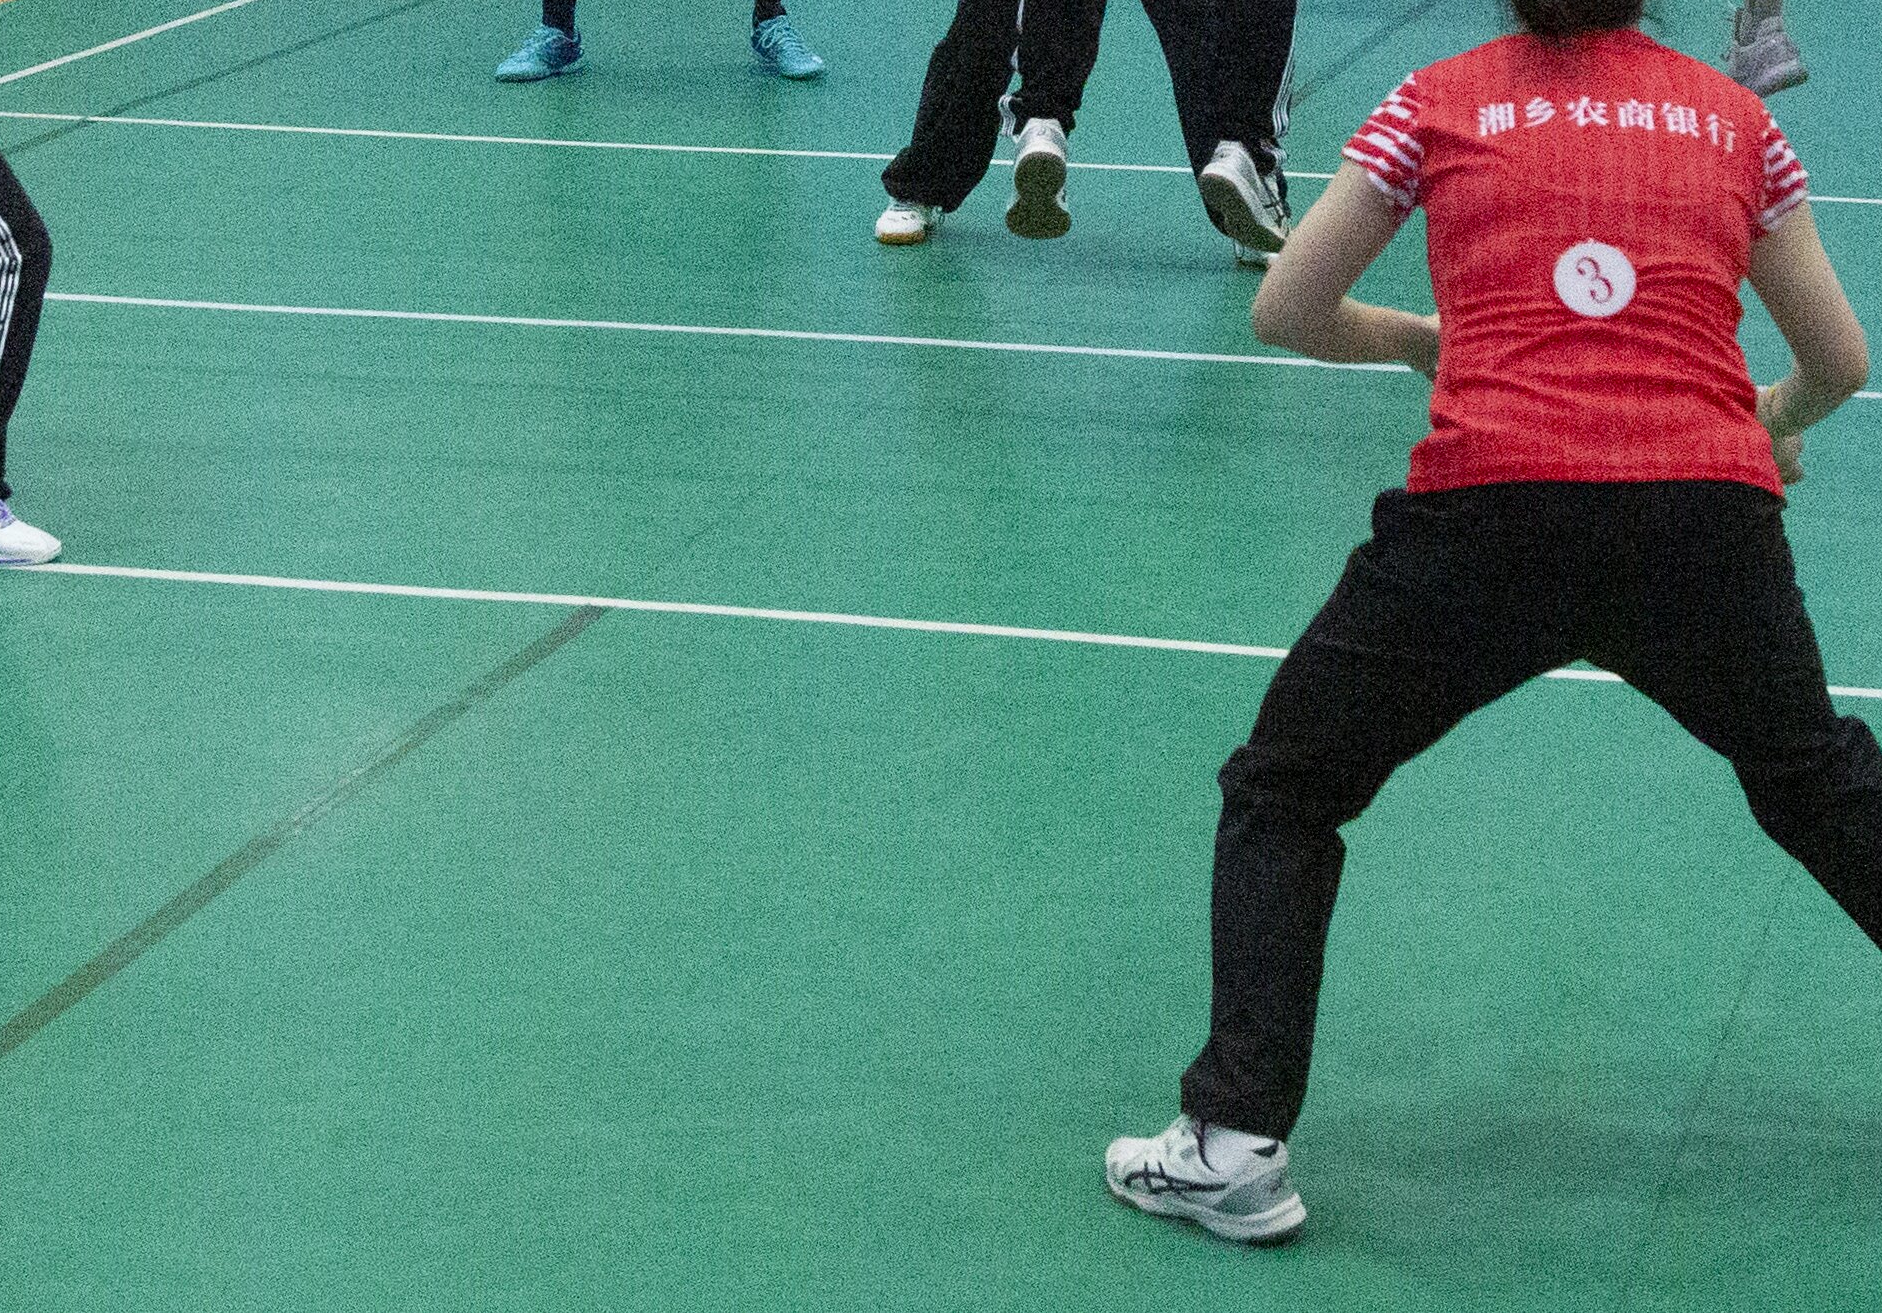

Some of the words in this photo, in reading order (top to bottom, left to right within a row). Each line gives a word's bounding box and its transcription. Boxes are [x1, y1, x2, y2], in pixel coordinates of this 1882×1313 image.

[1476, 94, 1737, 155] 湘乡农商银行
[1574, 254, 1616, 306] 3
